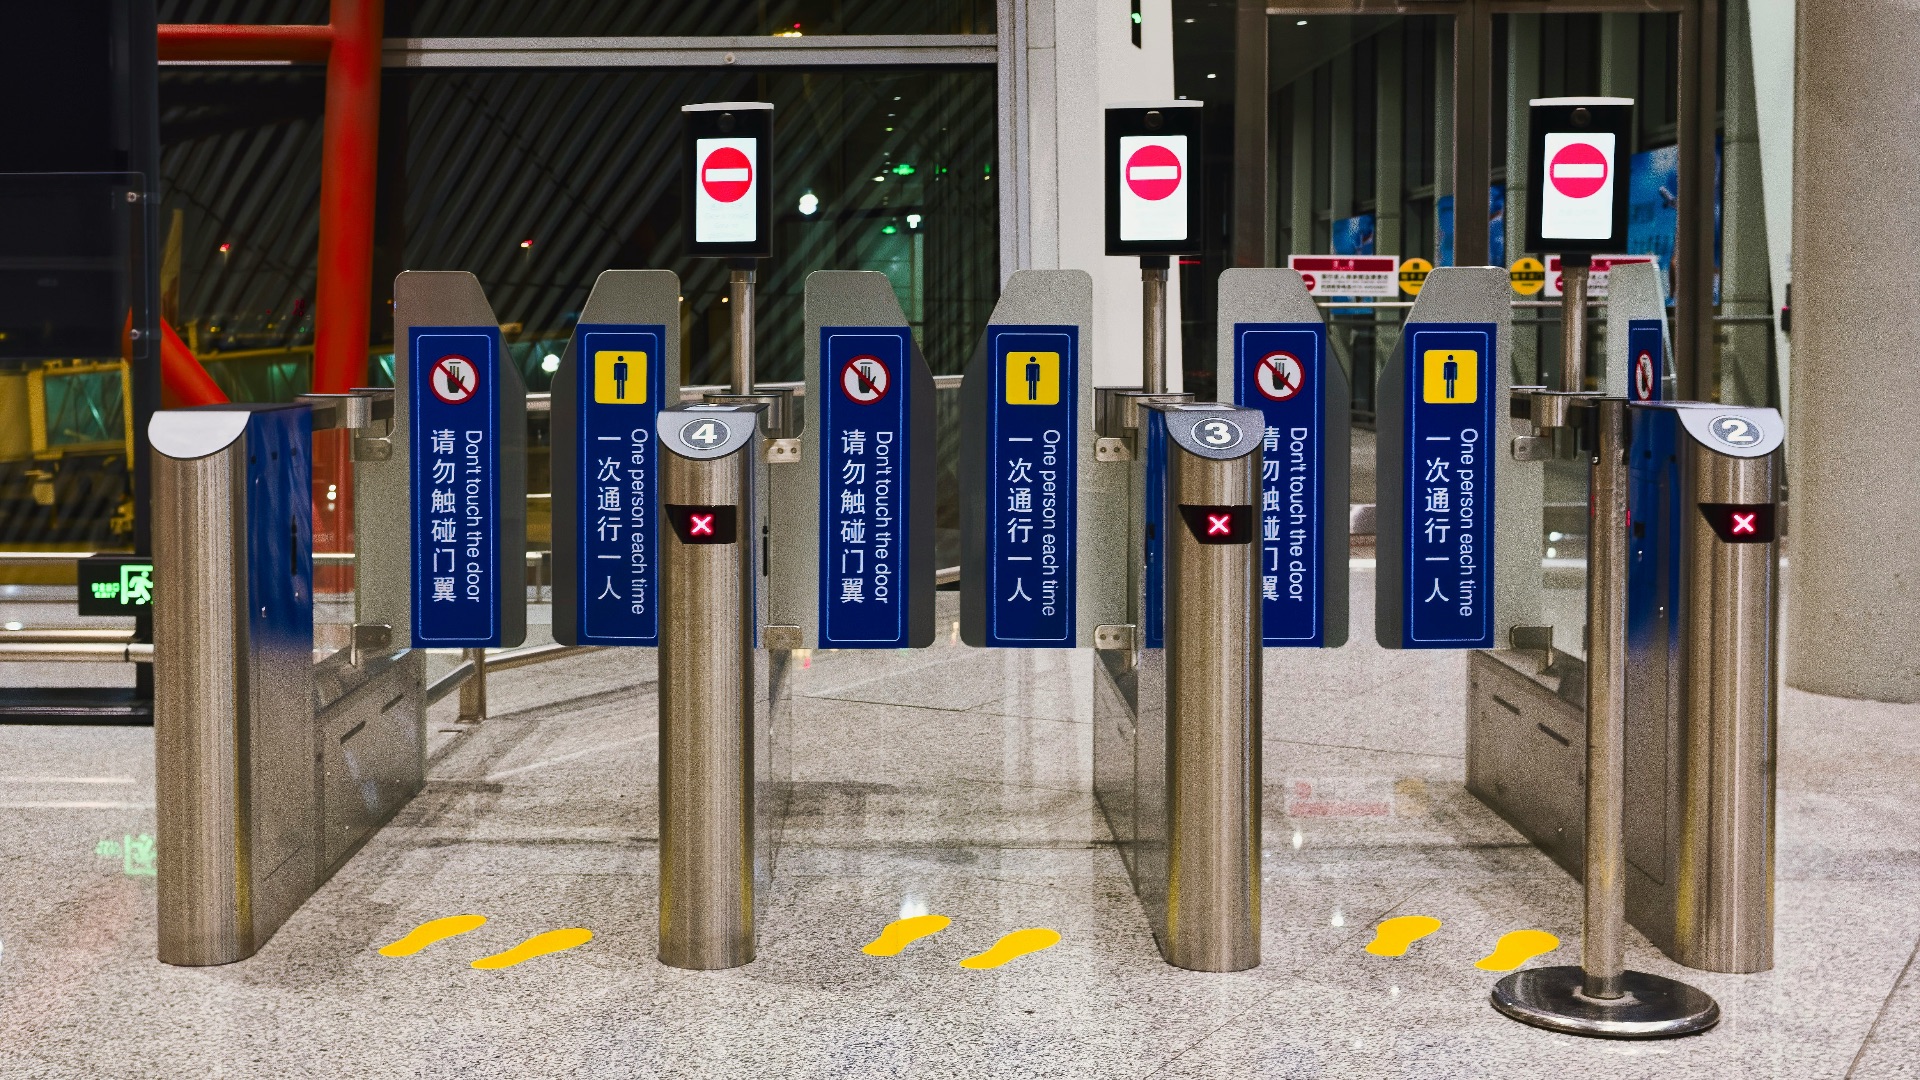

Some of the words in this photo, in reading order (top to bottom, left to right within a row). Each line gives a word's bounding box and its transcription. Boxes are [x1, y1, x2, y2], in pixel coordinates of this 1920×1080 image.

[630, 428, 649, 465] One
[691, 423, 717, 444] 4
[1042, 429, 1061, 466] One
[1204, 422, 1232, 445] 3
[1289, 427, 1308, 472] Don't
[1460, 428, 1479, 465] One
[1722, 419, 1753, 442] 2
[465, 430, 483, 474] Don't
[875, 431, 894, 476] Don't
[430, 428, 457, 602] 请勿触碰门翼
[465, 477, 482, 527] touch
[597, 436, 622, 600] 一次通行一人
[627, 469, 645, 528] person
[840, 428, 867, 604] 请勿触碰门翼
[875, 478, 893, 528] touch
[1007, 437, 1034, 602] 一次通行一人
[1038, 470, 1057, 529] person
[1289, 475, 1307, 525] touch
[1425, 436, 1451, 603] 一次通行一人
[1456, 469, 1474, 529] person
[465, 530, 482, 558] the
[630, 532, 648, 574] each
[874, 531, 891, 559] the
[1042, 533, 1060, 575] each
[1289, 528, 1307, 557] the
[1459, 533, 1477, 575] each
[465, 561, 484, 603] door
[630, 578, 648, 615] time
[874, 563, 892, 604] door
[1041, 579, 1059, 616] time
[1288, 560, 1307, 602] door
[1459, 579, 1477, 617] time
